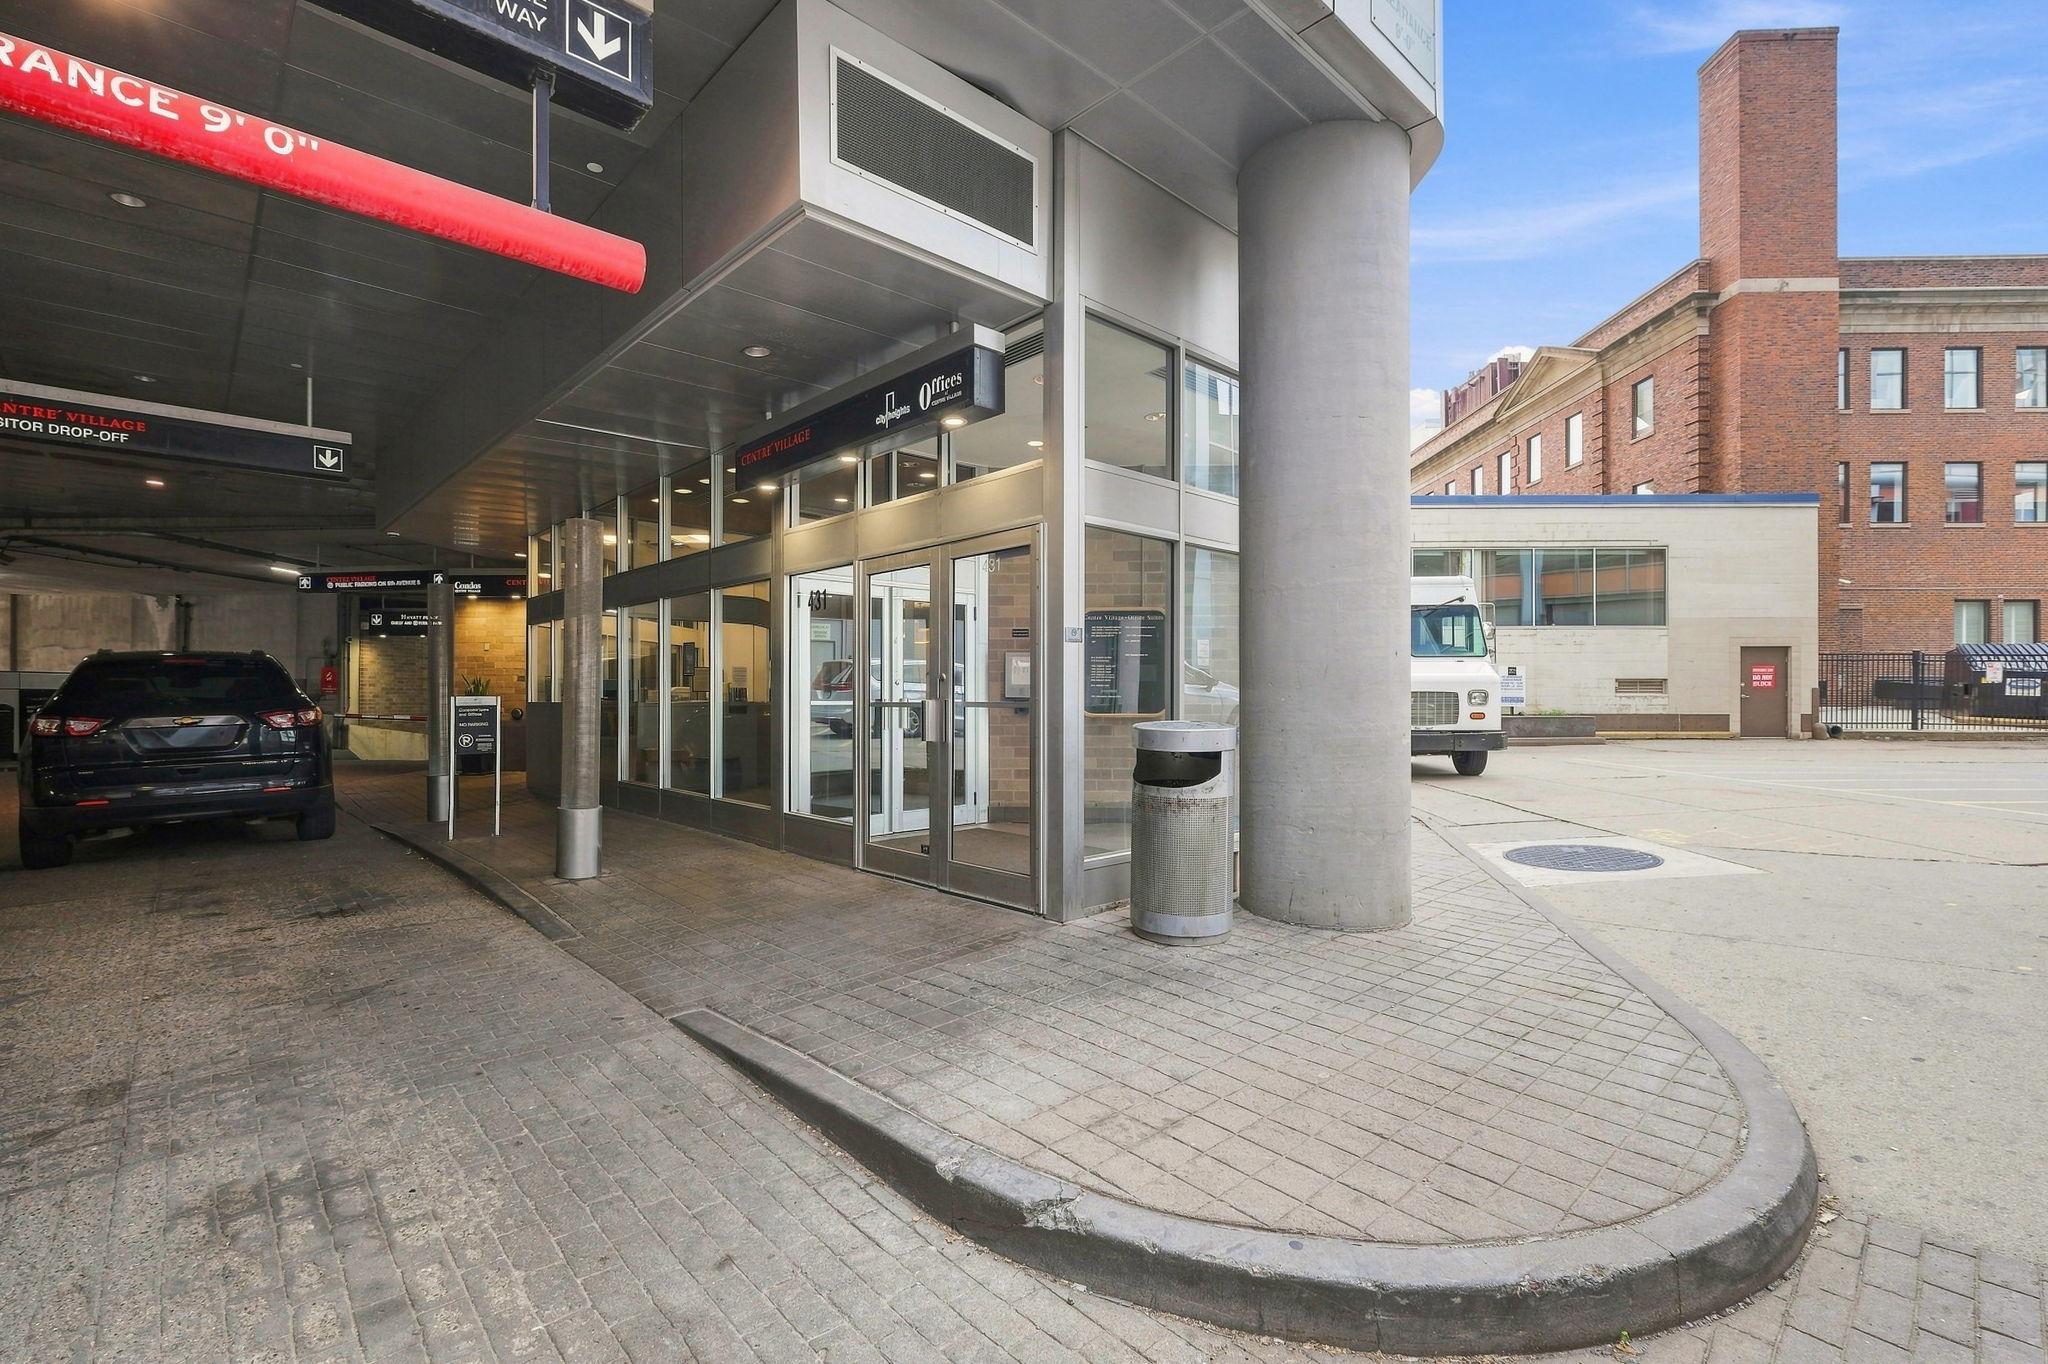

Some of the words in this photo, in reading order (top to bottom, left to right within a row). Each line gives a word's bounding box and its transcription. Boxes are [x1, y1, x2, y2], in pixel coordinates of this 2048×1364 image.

[496, 0, 547, 32] WAY
[919, 372, 962, 411] Offices
[66, 411, 146, 432] VILLAGE
[48, 423, 130, 443] DROP-OFF
[774, 428, 811, 452] VILLAGE
[454, 581, 482, 590] Condos
[808, 589, 827, 611] 431
